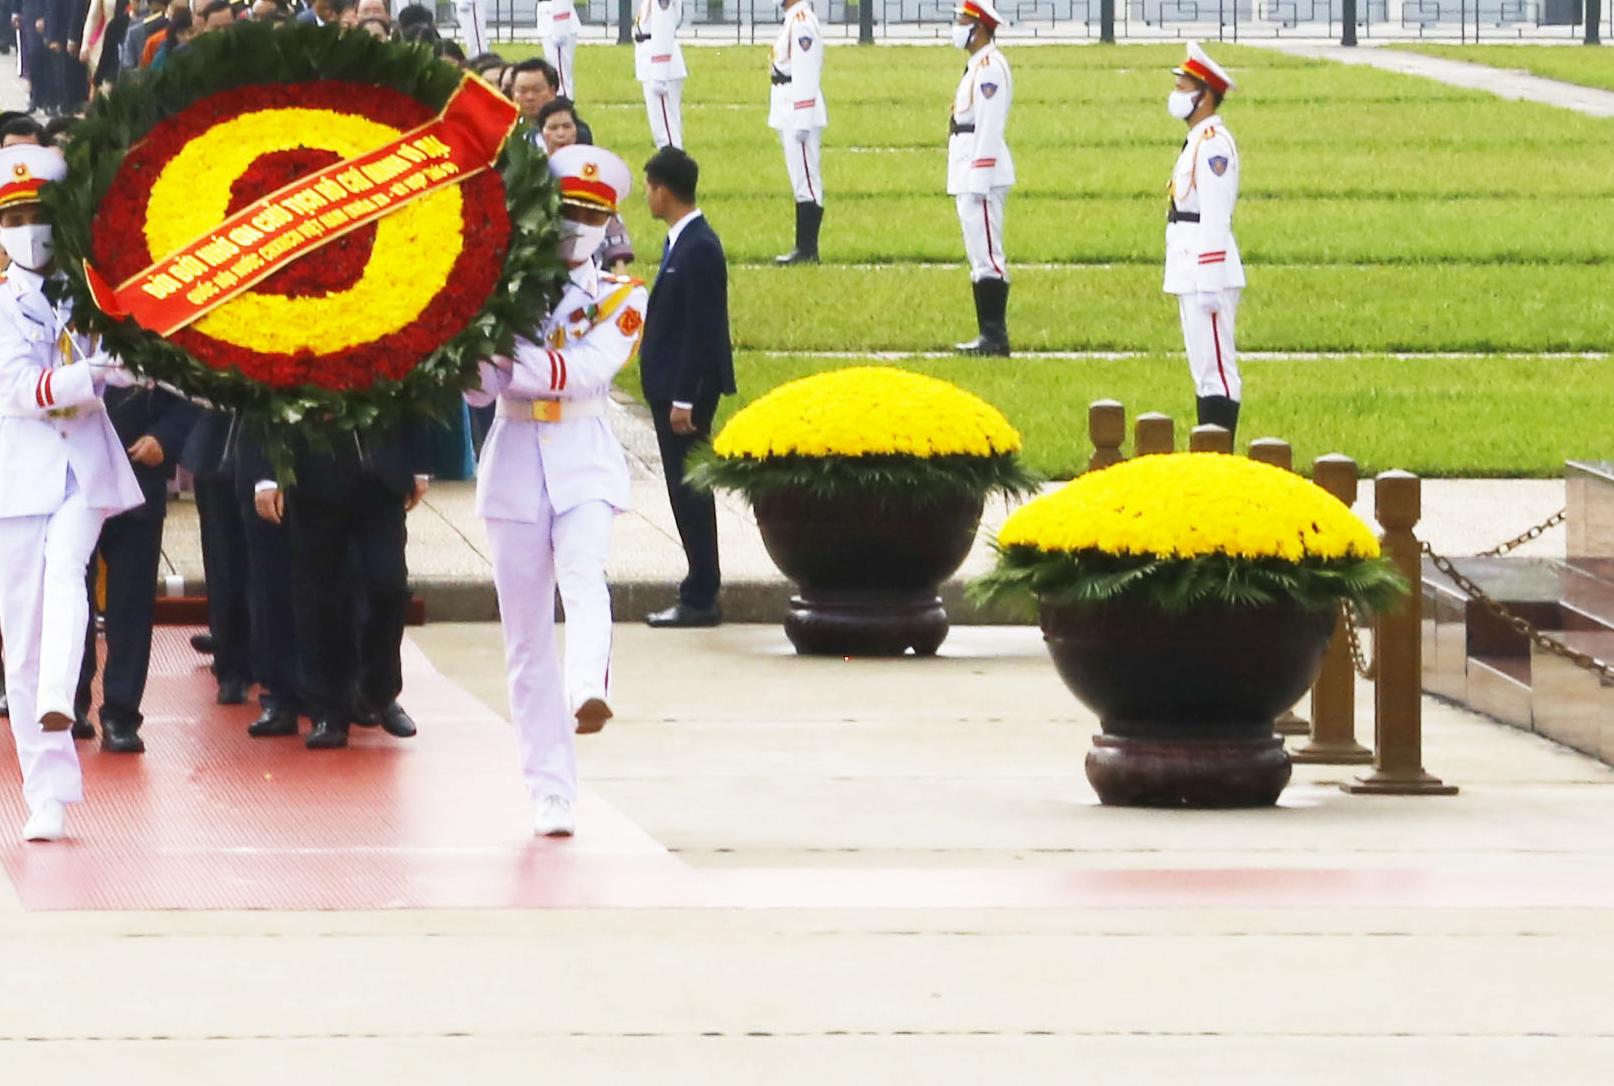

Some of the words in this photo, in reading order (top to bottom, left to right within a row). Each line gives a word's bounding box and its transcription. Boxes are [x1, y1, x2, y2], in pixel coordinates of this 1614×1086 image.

[251, 201, 294, 232] CHỦ
[280, 187, 329, 216] TỊCH
[336, 165, 375, 194] CHÍ
